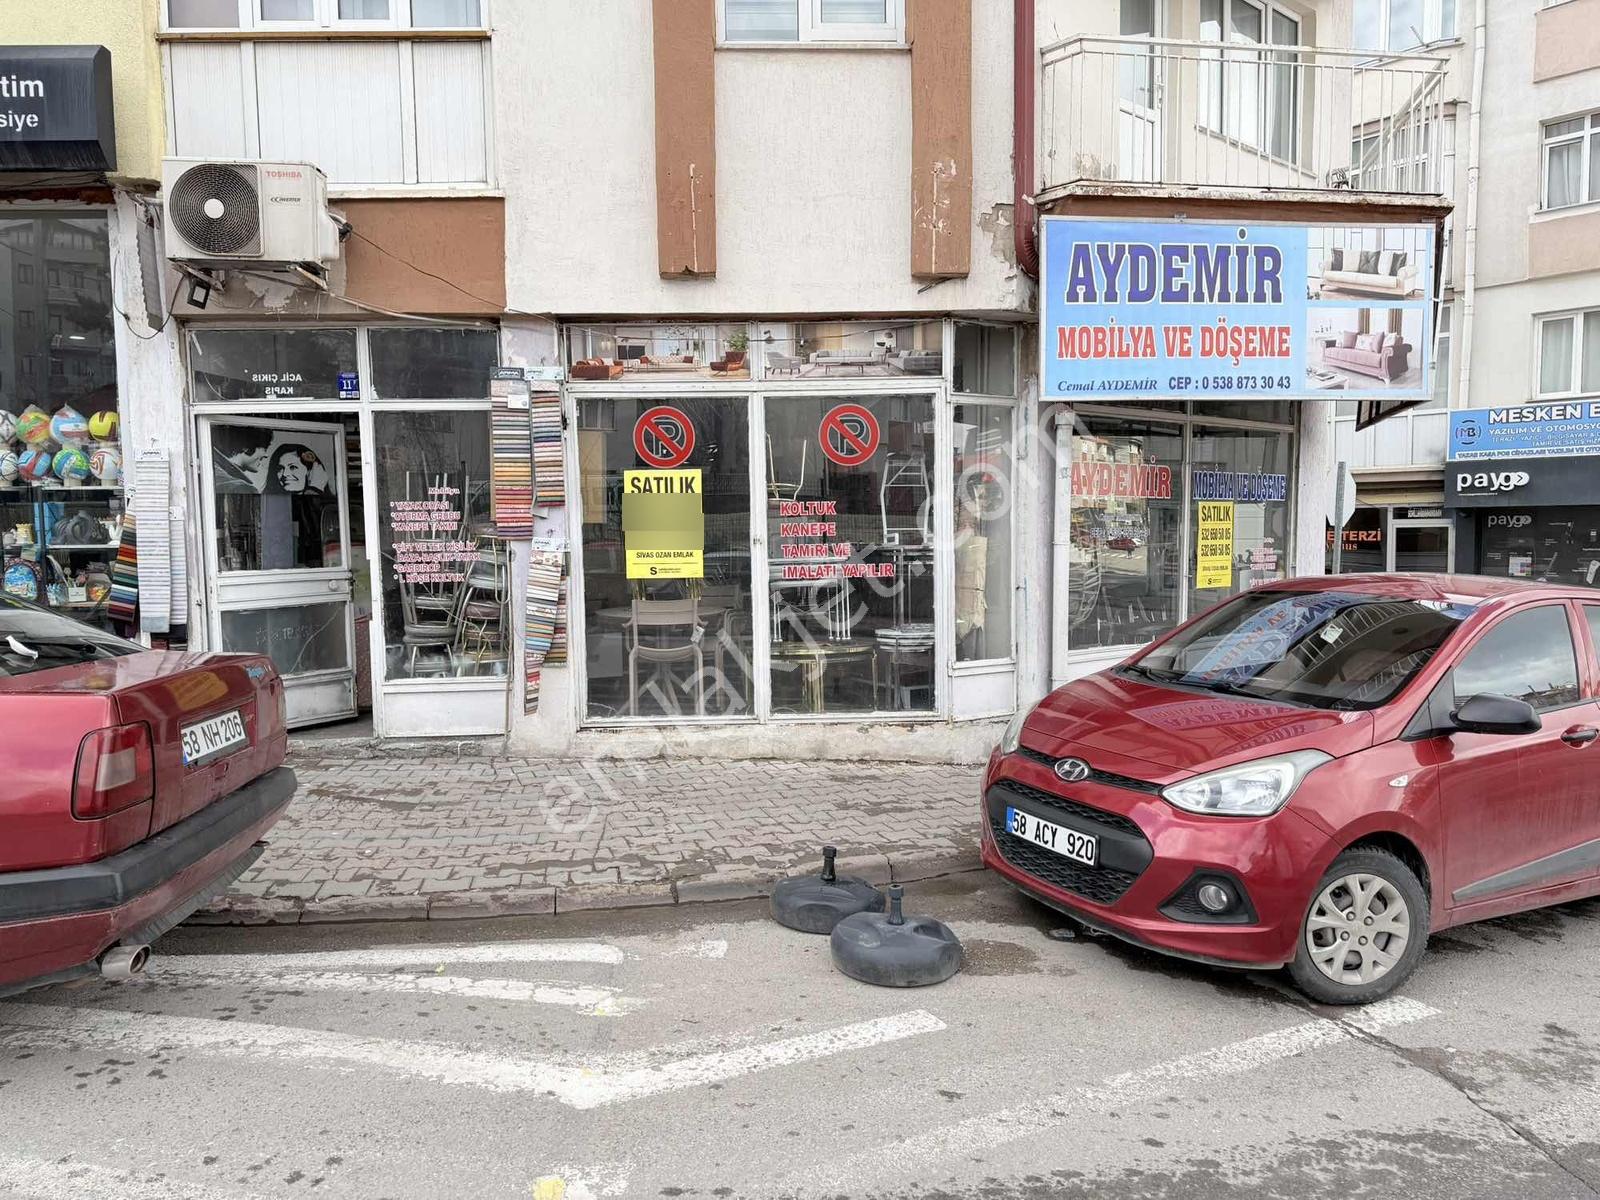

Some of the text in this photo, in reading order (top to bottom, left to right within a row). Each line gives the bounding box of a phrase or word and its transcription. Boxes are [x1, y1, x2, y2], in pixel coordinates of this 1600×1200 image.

[1065, 227, 1282, 305] AYDEMİR
[1057, 317, 1291, 366] MOBİLYA VE DÖŞEME
[1058, 377, 1158, 391] Cemal AYDEMİR
[1168, 376, 1191, 390] CEP
[1202, 376, 1209, 389] 0
[1212, 376, 1233, 389] 538
[1236, 376, 1257, 389] 873
[1260, 376, 1274, 389] 30
[1277, 376, 1291, 389] 43
[1488, 403, 1582, 424] MESKEN
[1070, 455, 1171, 499] AYDEMİR
[1237, 472, 1249, 501] VE
[780, 501, 837, 515] KOLTUK
[1201, 505, 1231, 521] SATILIK
[780, 522, 836, 537] KANEPE
[832, 543, 851, 557] VE
[841, 563, 894, 577] YAPILIR
[181, 715, 242, 756] 58 NH 206
[1012, 811, 1094, 861] 58 ACY 920
